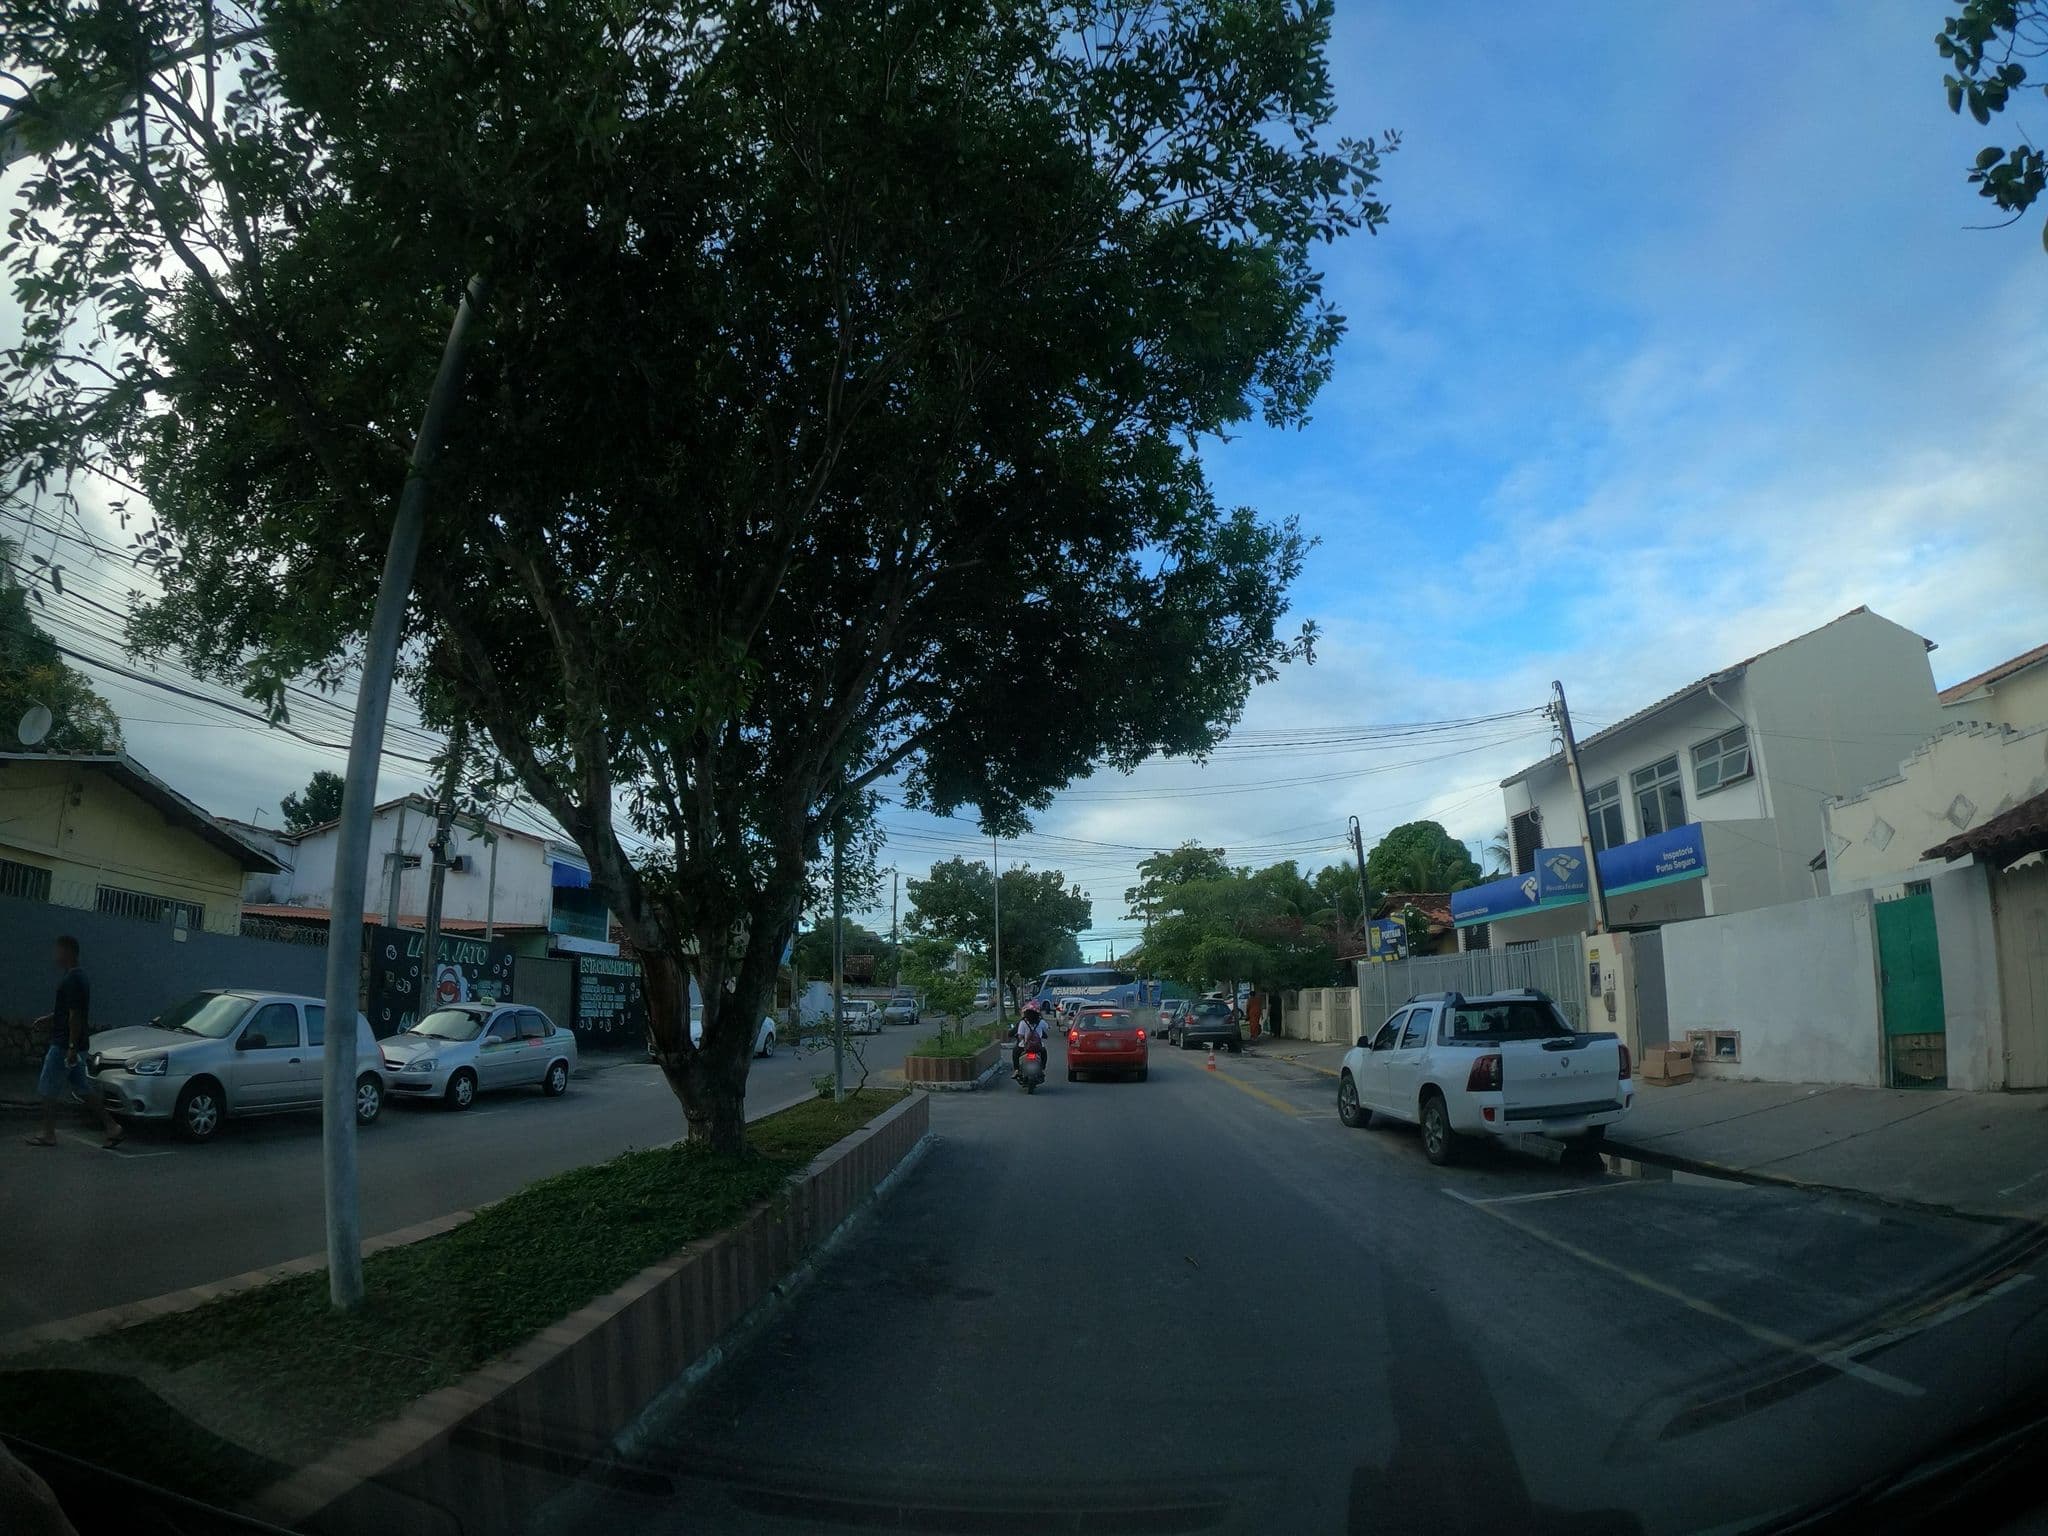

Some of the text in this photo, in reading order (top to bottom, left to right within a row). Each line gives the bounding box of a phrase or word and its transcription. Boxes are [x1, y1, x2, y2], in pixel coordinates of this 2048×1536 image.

[1673, 857, 1697, 870] Seguro
[406, 935, 488, 966] LAA JATO
